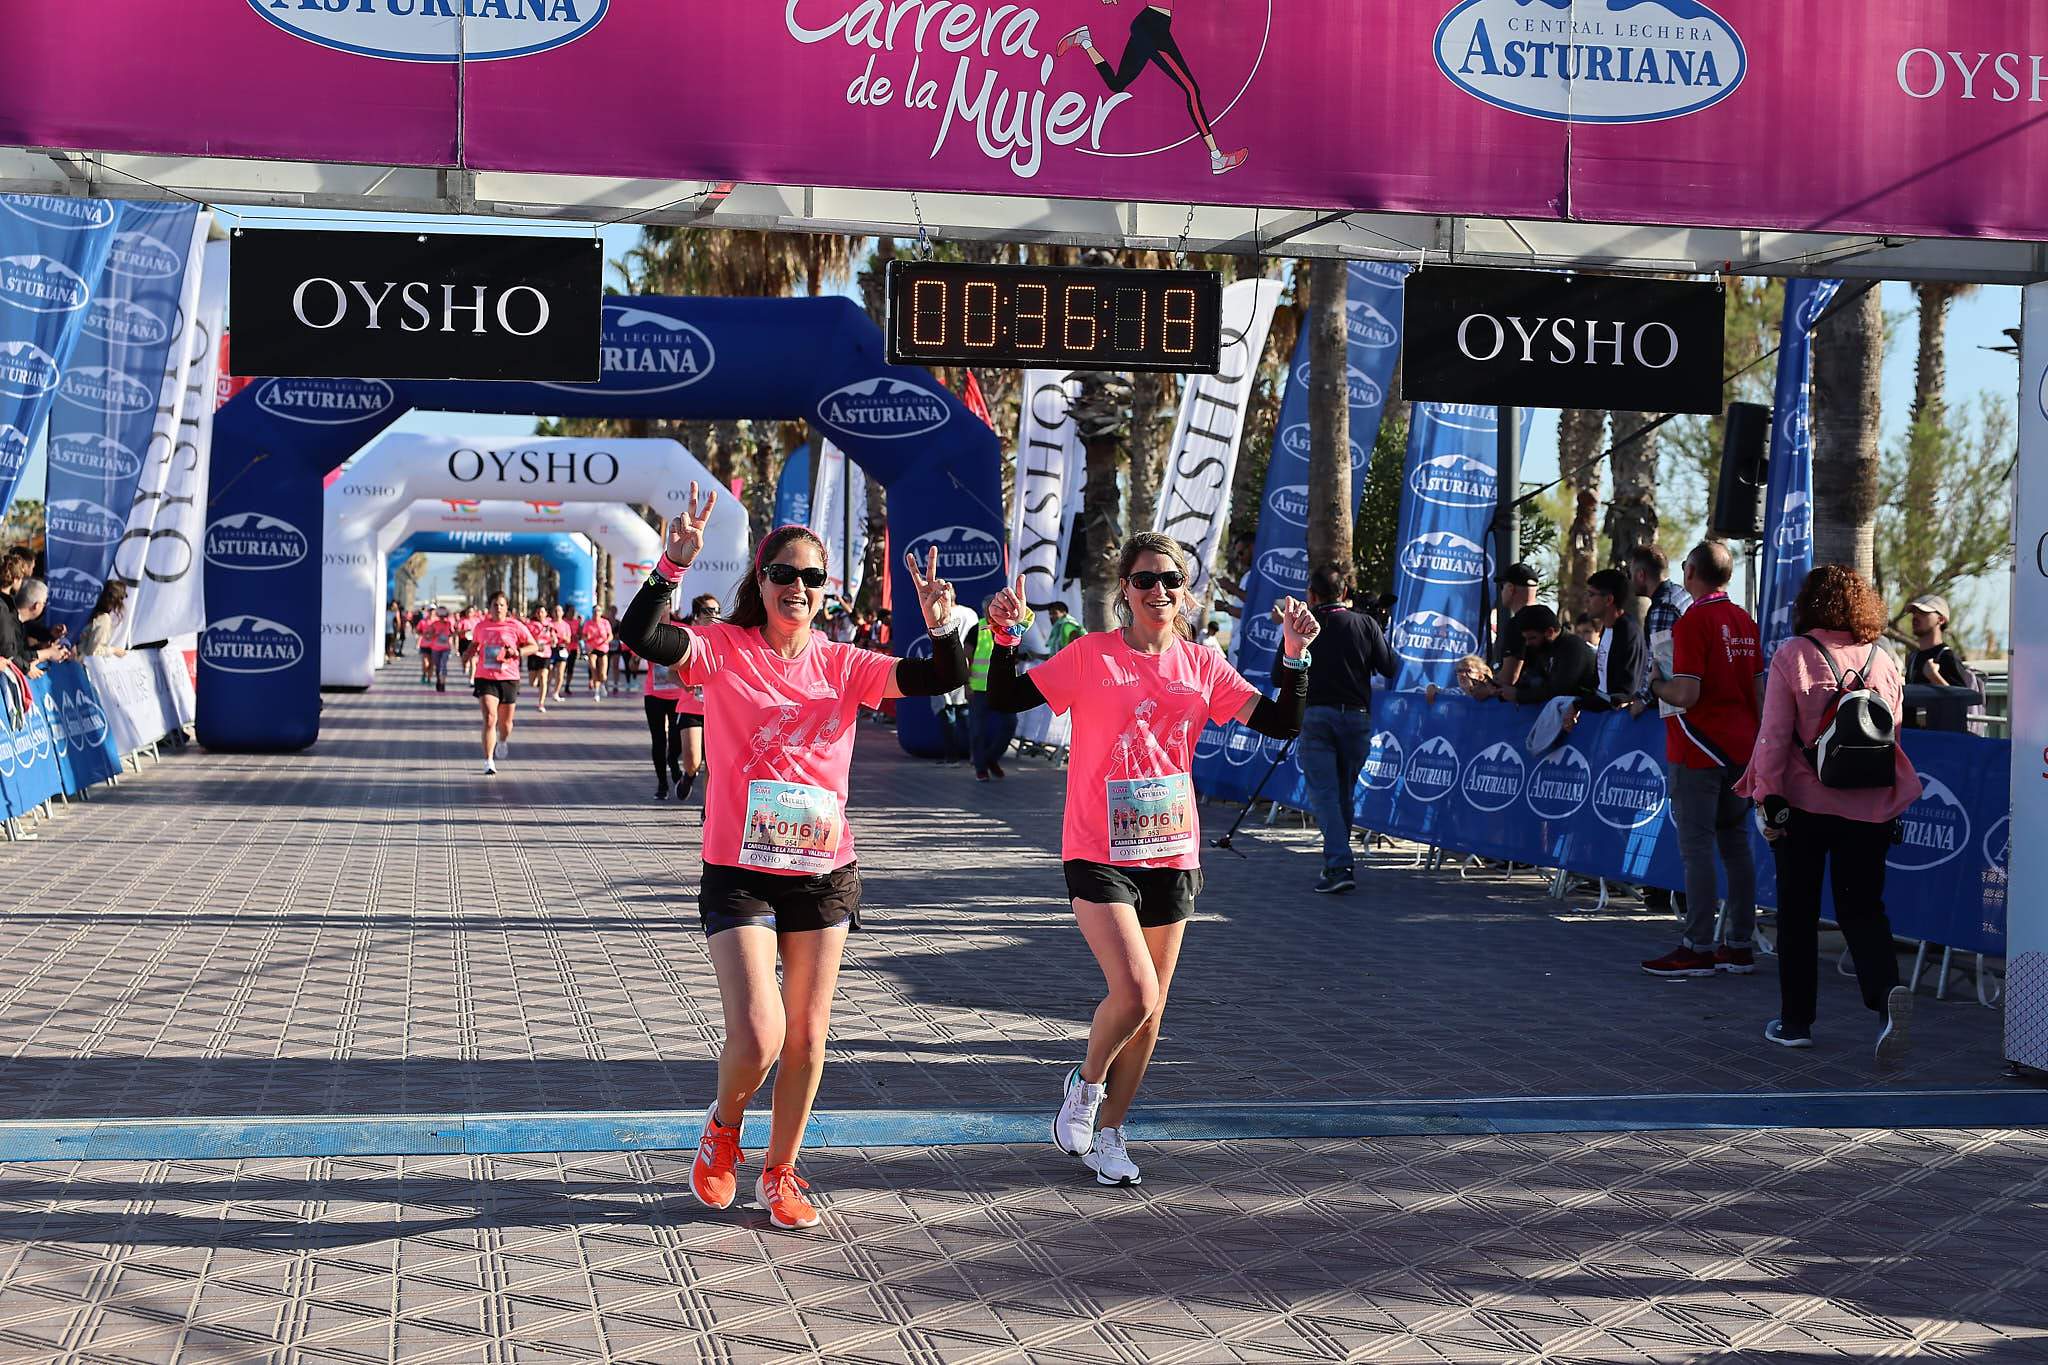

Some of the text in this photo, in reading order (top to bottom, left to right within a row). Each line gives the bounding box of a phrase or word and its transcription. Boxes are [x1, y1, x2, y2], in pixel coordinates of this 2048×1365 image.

[1508, 17, 1712, 41] CENTRAL LECHERA
[1458, 18, 1722, 87] ASTURIANA
[846, 54, 1133, 178] de la Mujer
[0, 268, 79, 306] STURIANA
[293, 278, 550, 336] OYSHO
[913, 280, 1195, 353] 00:36:18
[623, 332, 692, 344] LECHERA
[1457, 313, 1679, 369] OYSHO
[601, 347, 699, 373] RIANA
[264, 383, 382, 409] ASTURIANA
[829, 401, 942, 424] ASTURIANA
[448, 449, 619, 485] OYSHO
[343, 484, 396, 497] OYSHO
[47, 517, 118, 539] STURIANA
[207, 532, 300, 557] ASTURIANA
[693, 560, 740, 572] OYSHO
[203, 635, 296, 659] ASTURIANA
[1407, 758, 1452, 787] ASTURIANA
[1465, 765, 1518, 795] ASTURIANA
[1530, 770, 1585, 802] ASTURIANA
[1595, 775, 1658, 812] ASTURIANA
[777, 821, 812, 838] 016
[1139, 812, 1170, 828] 016
[747, 843, 771, 852] CARRERA
[750, 853, 781, 864] OYSHO
[1119, 848, 1148, 857] OYSHO
